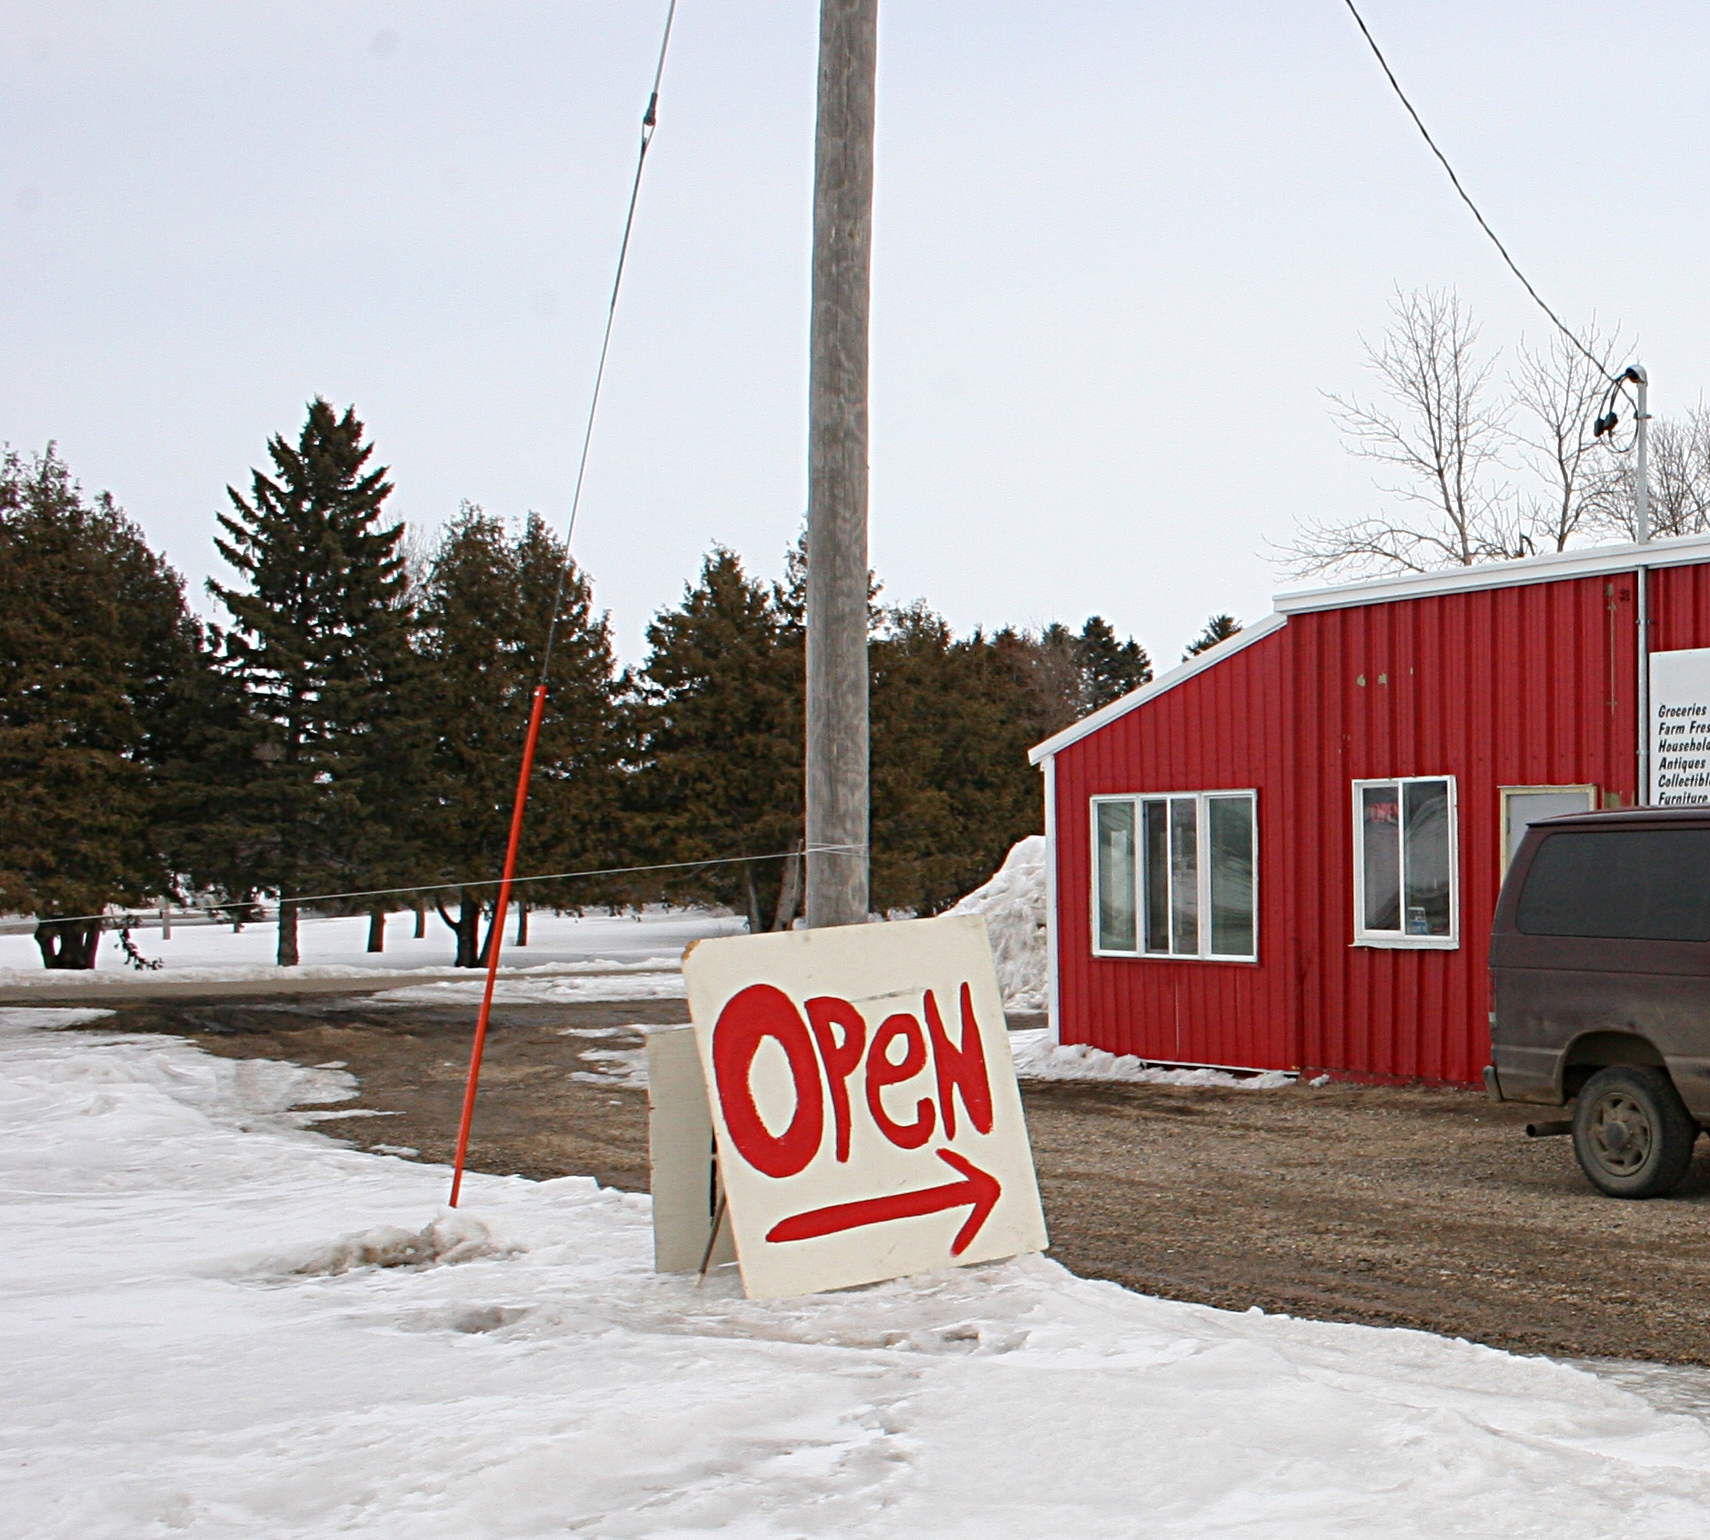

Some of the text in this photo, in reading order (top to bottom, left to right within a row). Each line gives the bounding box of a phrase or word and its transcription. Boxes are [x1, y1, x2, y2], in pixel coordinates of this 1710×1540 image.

[1658, 703, 1707, 718] Groceries
[1658, 722, 1686, 735] Farm
[1658, 756, 1706, 773] Antiques
[1658, 792, 1708, 805] Furniture
